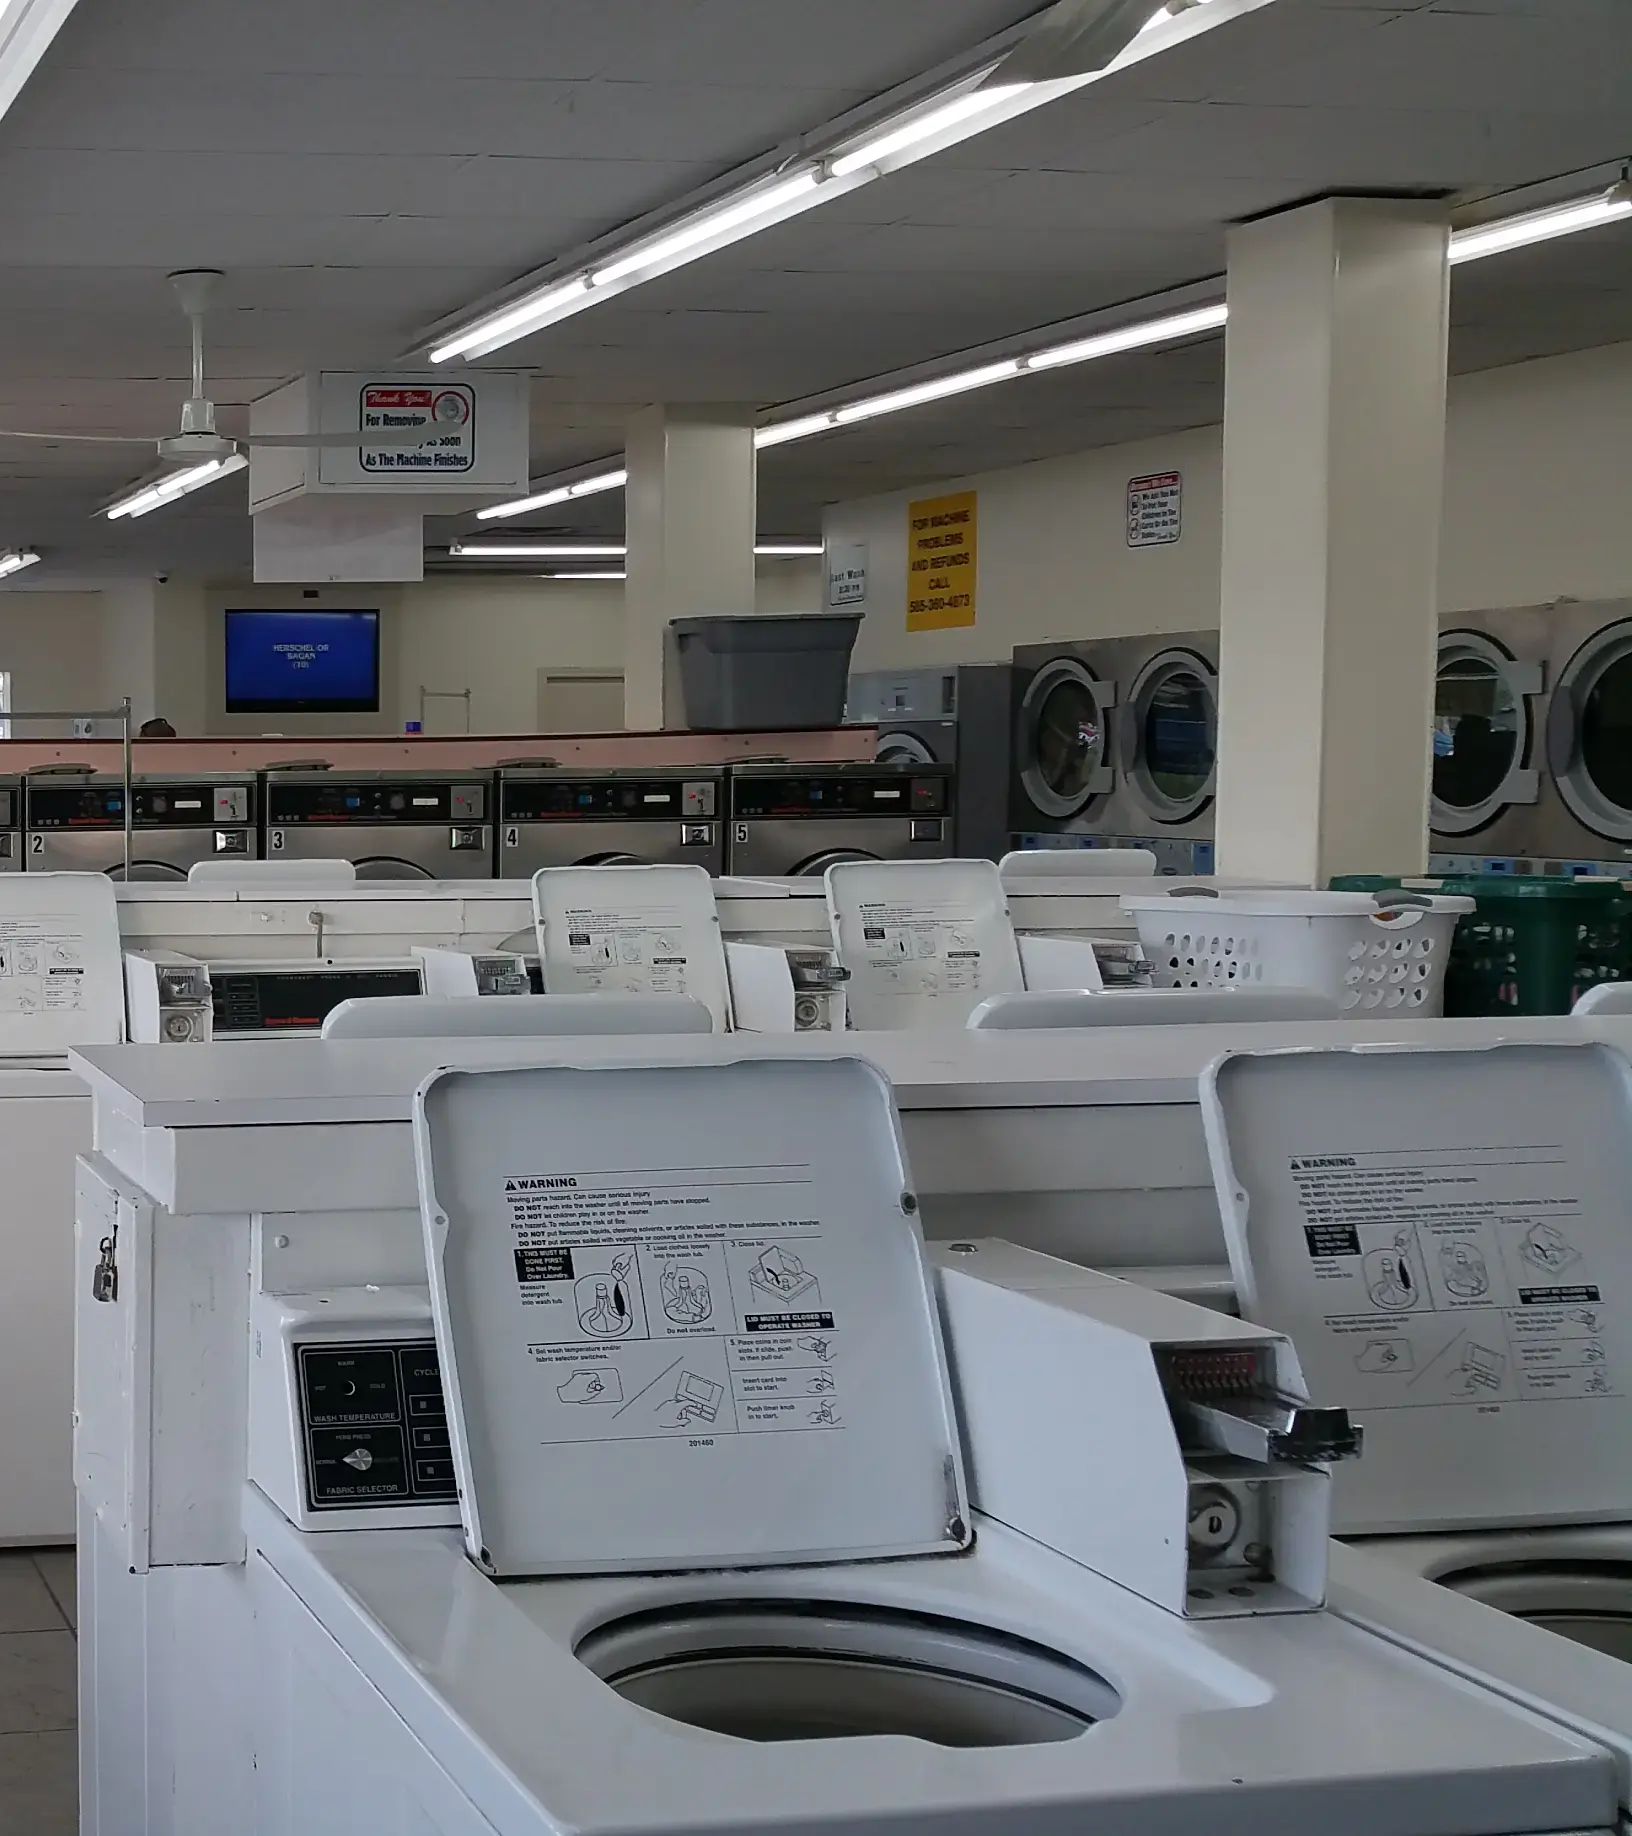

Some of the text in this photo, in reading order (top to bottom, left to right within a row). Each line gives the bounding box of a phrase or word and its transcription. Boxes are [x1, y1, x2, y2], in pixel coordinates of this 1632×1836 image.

[368, 391, 400, 402] Thank
[366, 414, 380, 426] For
[366, 453, 468, 466] As The Machine Finishes
[913, 510, 970, 530] FOR MACHINE
[917, 532, 963, 549] PROBLEMS
[912, 552, 970, 571] AND REFUNDS
[929, 577, 950, 590] CALL
[507, 829, 517, 846] 4
[738, 824, 747, 841] 5
[33, 836, 43, 853] 2
[273, 832, 283, 849] 3
[1302, 1158, 1356, 1168] WARNING
[518, 1178, 577, 1189] WARNING
[414, 1368, 439, 1376] CYCLE
[339, 1413, 395, 1421] TEMPERATURE
[356, 1485, 398, 1493] SELECTOR
